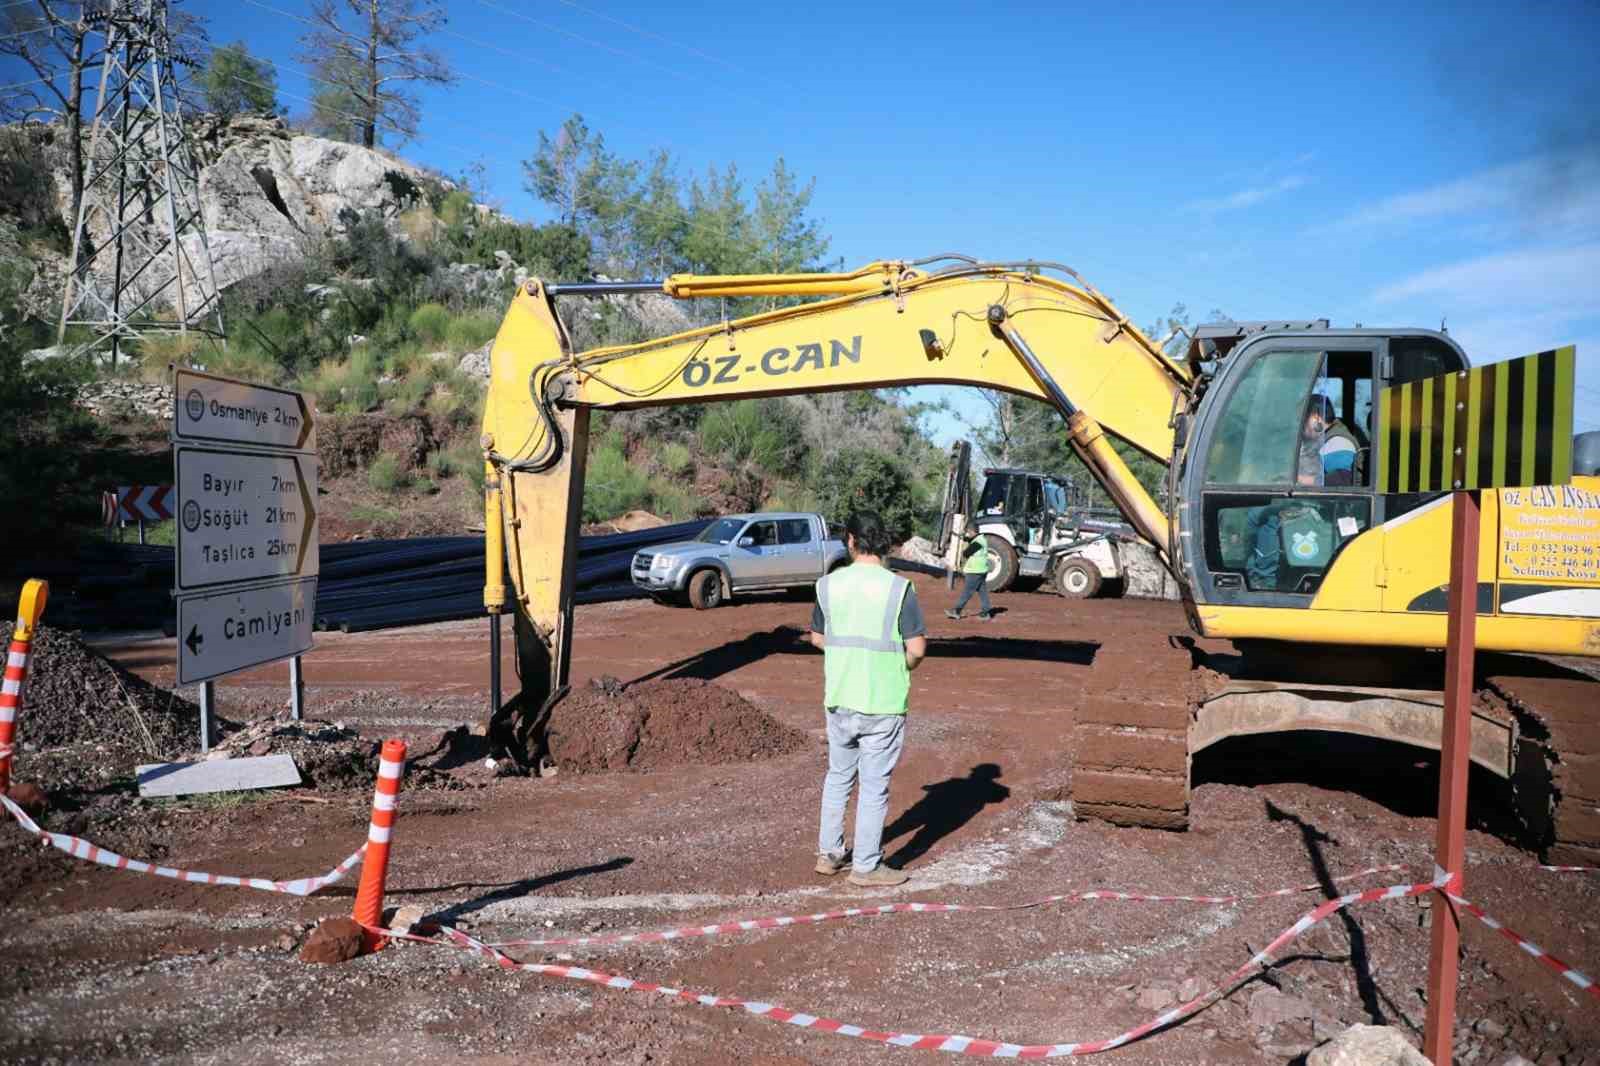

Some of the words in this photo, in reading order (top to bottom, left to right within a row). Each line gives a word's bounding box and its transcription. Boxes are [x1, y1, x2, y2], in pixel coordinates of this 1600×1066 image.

[682, 335, 863, 388] ÖZ-CAN
[209, 399, 269, 427] Osmaniye
[203, 473, 244, 496] Bayır
[203, 509, 249, 530] Söğüt
[223, 608, 305, 639] Camiyanı
